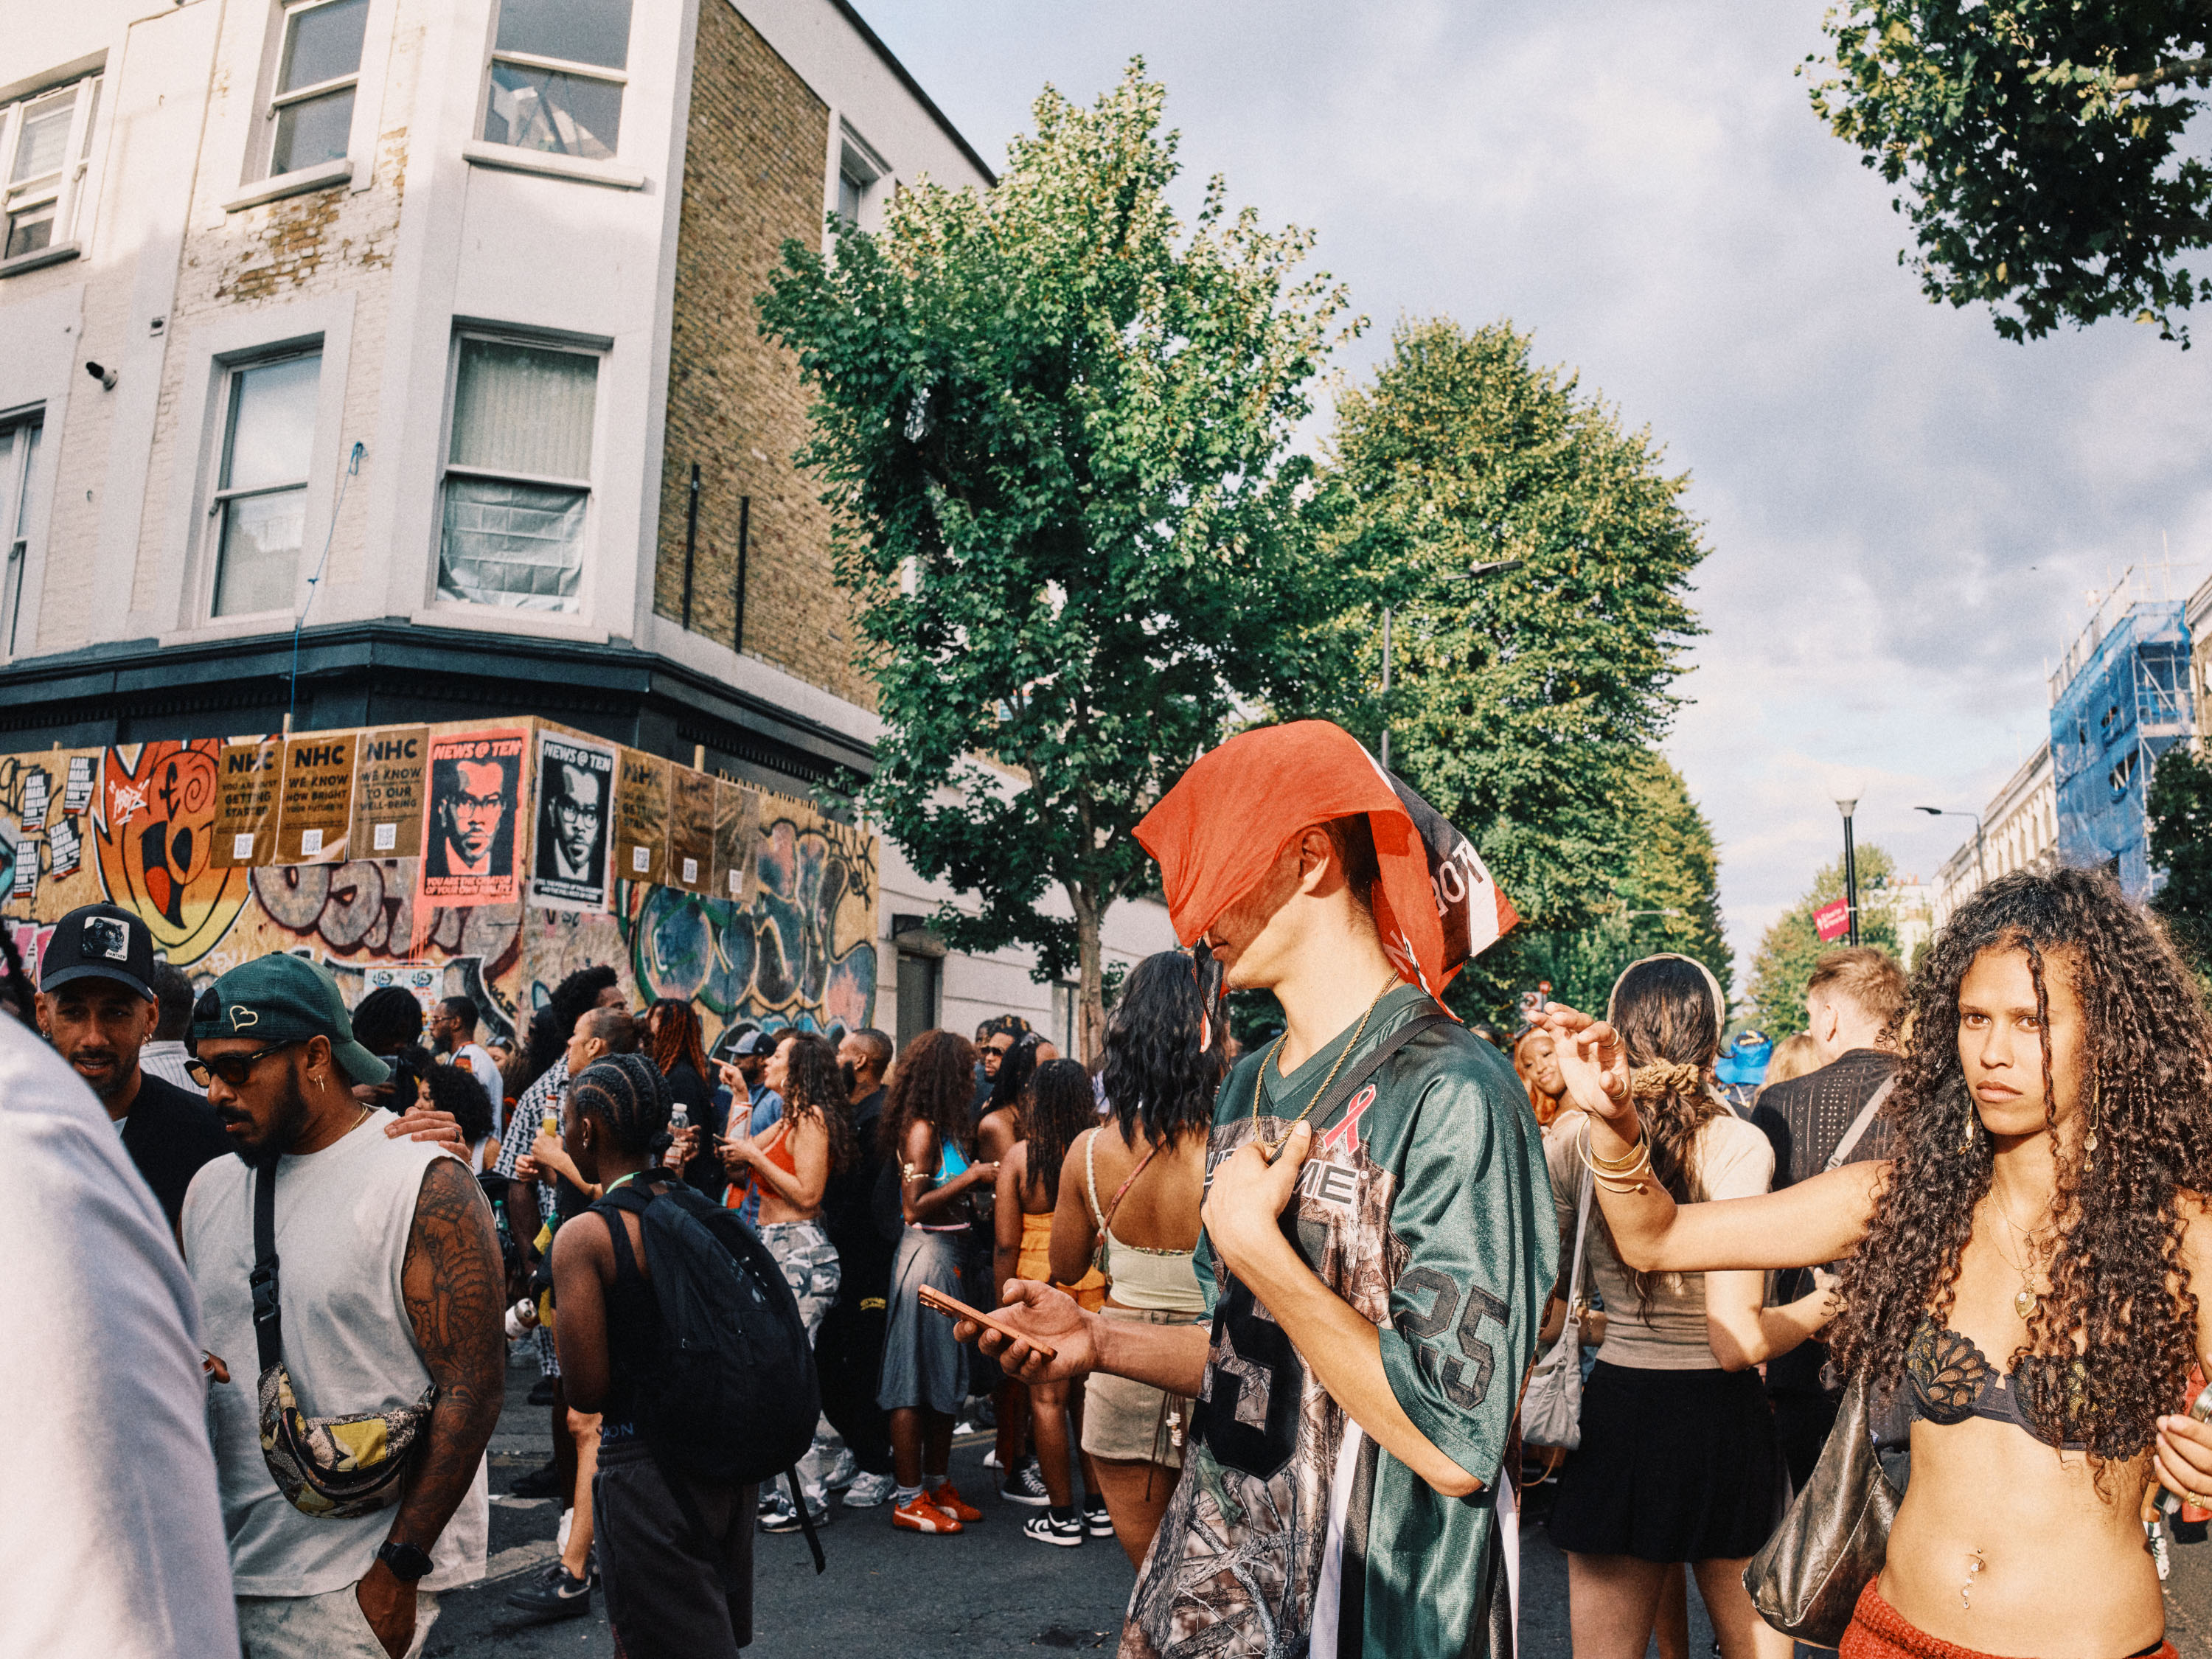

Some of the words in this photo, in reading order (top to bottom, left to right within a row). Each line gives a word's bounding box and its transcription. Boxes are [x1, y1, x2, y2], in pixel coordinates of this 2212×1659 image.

[295, 745, 345, 768] NHC
[367, 739, 418, 761] NHC
[434, 743, 476, 760] NEWS
[475, 742, 490, 759] @
[492, 740, 522, 757] TEN
[544, 742, 577, 763] NEWS
[577, 751, 588, 767] @
[590, 754, 611, 772] TEN
[229, 751, 274, 773] NHC
[289, 776, 307, 787] WE
[311, 773, 348, 787] KNOW
[361, 770, 379, 781] WE
[383, 767, 422, 779] KNOW
[286, 792, 308, 802] HOW
[312, 790, 347, 801] BRIGHT
[366, 787, 381, 799] TO
[387, 786, 411, 798] OUR
[361, 799, 417, 811] WELL-BEING
[427, 877, 444, 886] YOU
[444, 876, 459, 886] ARE
[460, 876, 476, 886] THE
[476, 874, 512, 885] CREATOR
[425, 886, 437, 895] OF
[437, 886, 458, 894] YOUR
[459, 885, 479, 894] OWN
[107, 951, 126, 959] PANTHER
[1394, 1266, 1512, 1411] 25
